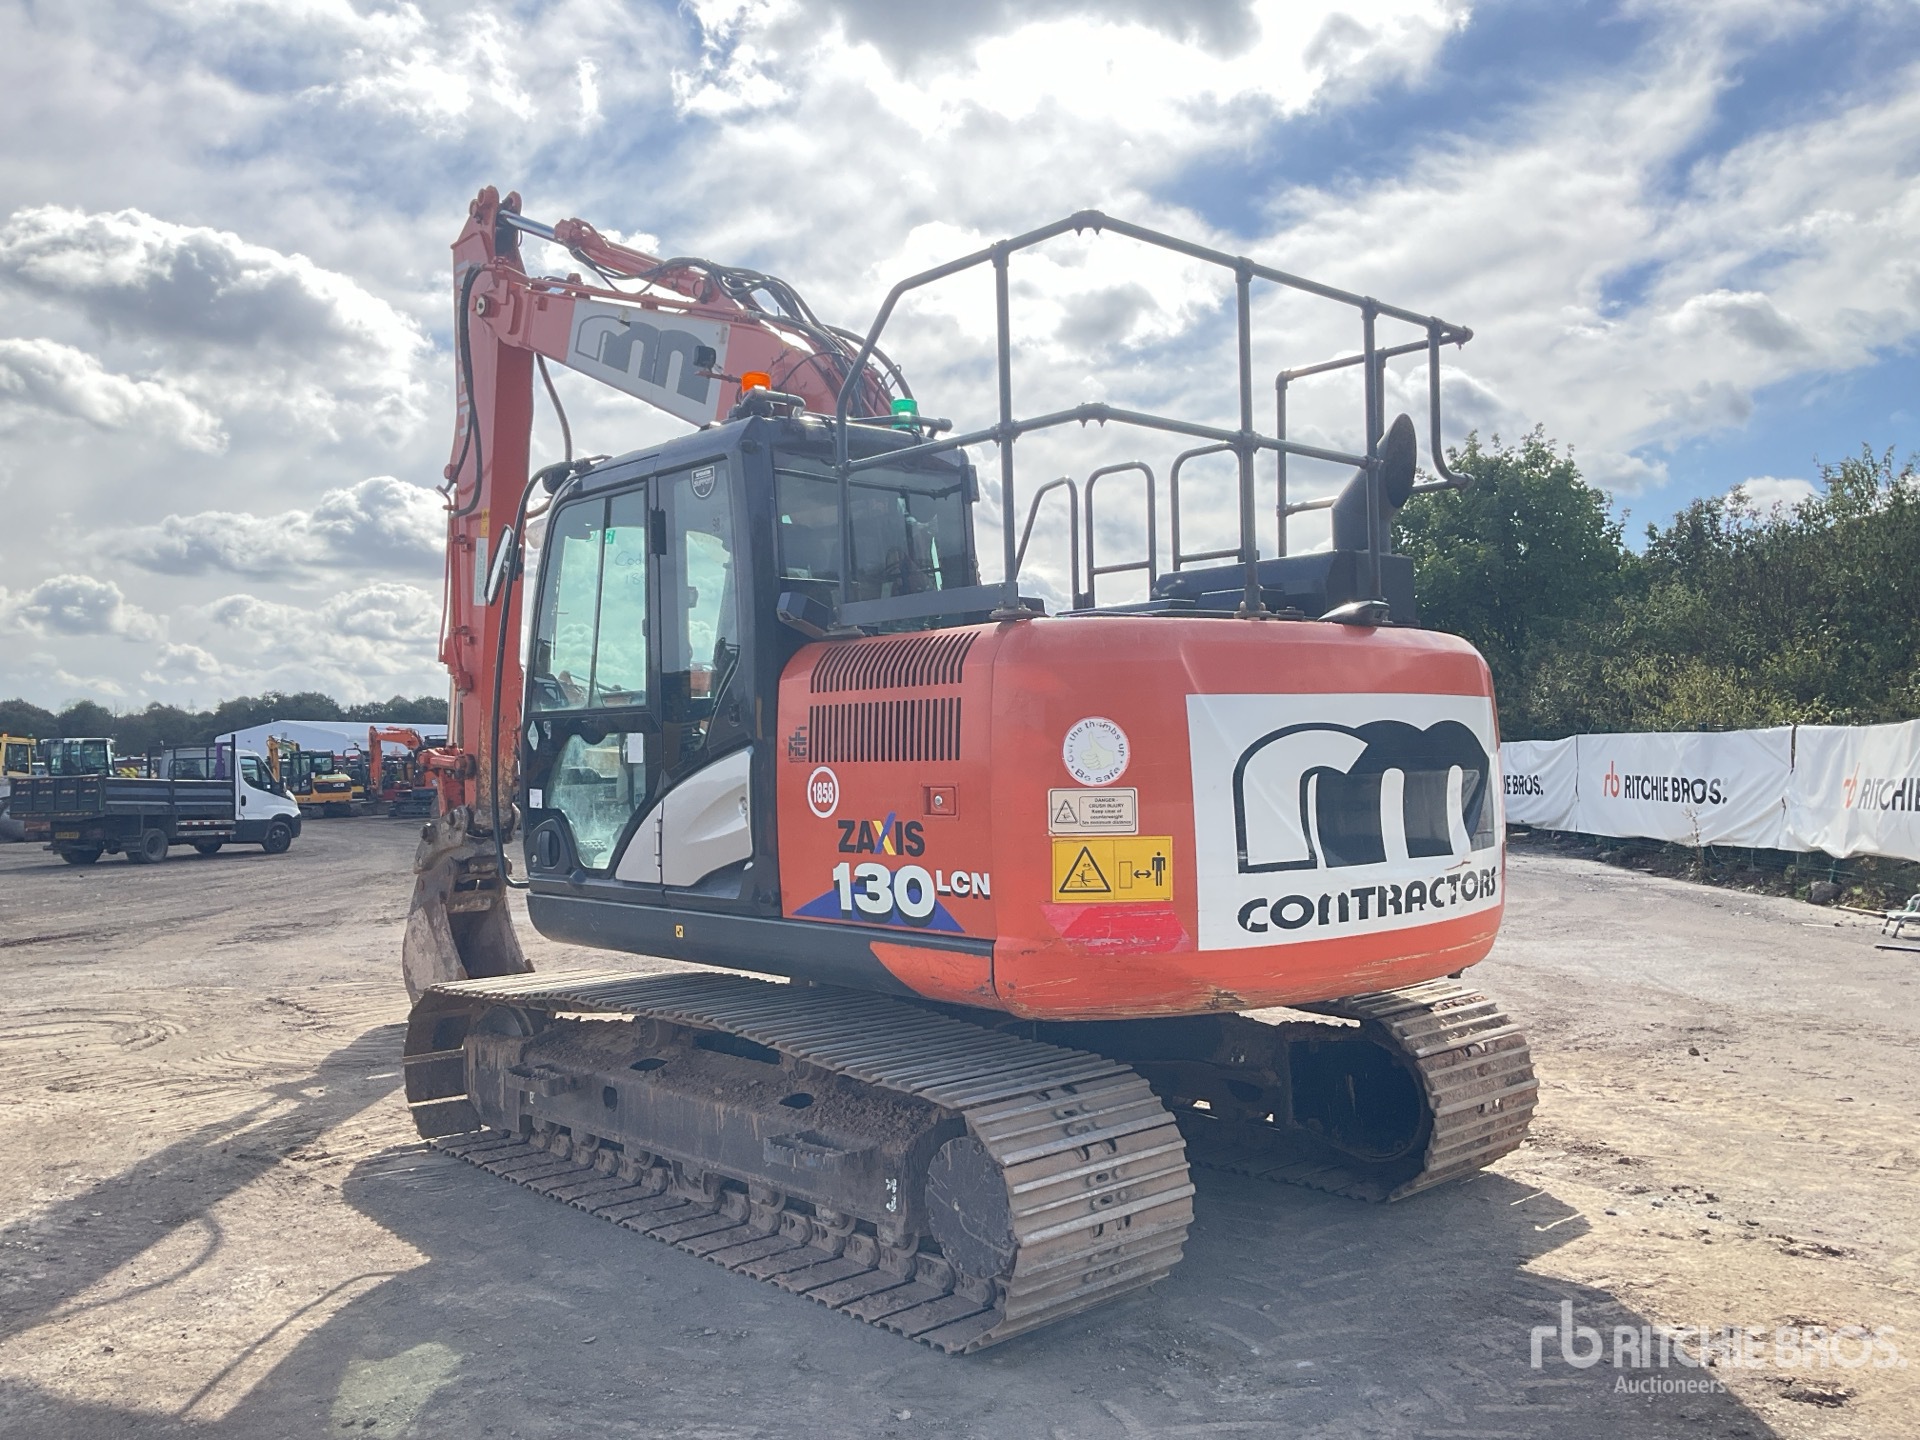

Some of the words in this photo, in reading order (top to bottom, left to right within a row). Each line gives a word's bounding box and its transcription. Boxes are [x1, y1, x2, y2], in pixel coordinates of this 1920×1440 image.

[615, 550, 645, 567] Cod
[1068, 727, 1083, 741] the
[1117, 743, 1125, 757] up
[812, 781, 834, 804] 1858
[1512, 774, 1544, 796] BROS.
[1603, 761, 1620, 798] rb
[1624, 774, 1669, 802] RITCHIE
[1671, 777, 1728, 805] BROS.
[837, 811, 925, 857] ZAXIS
[832, 862, 936, 923] 130
[935, 870, 991, 900] LCN
[1237, 865, 1497, 933] CONTRACTORS
